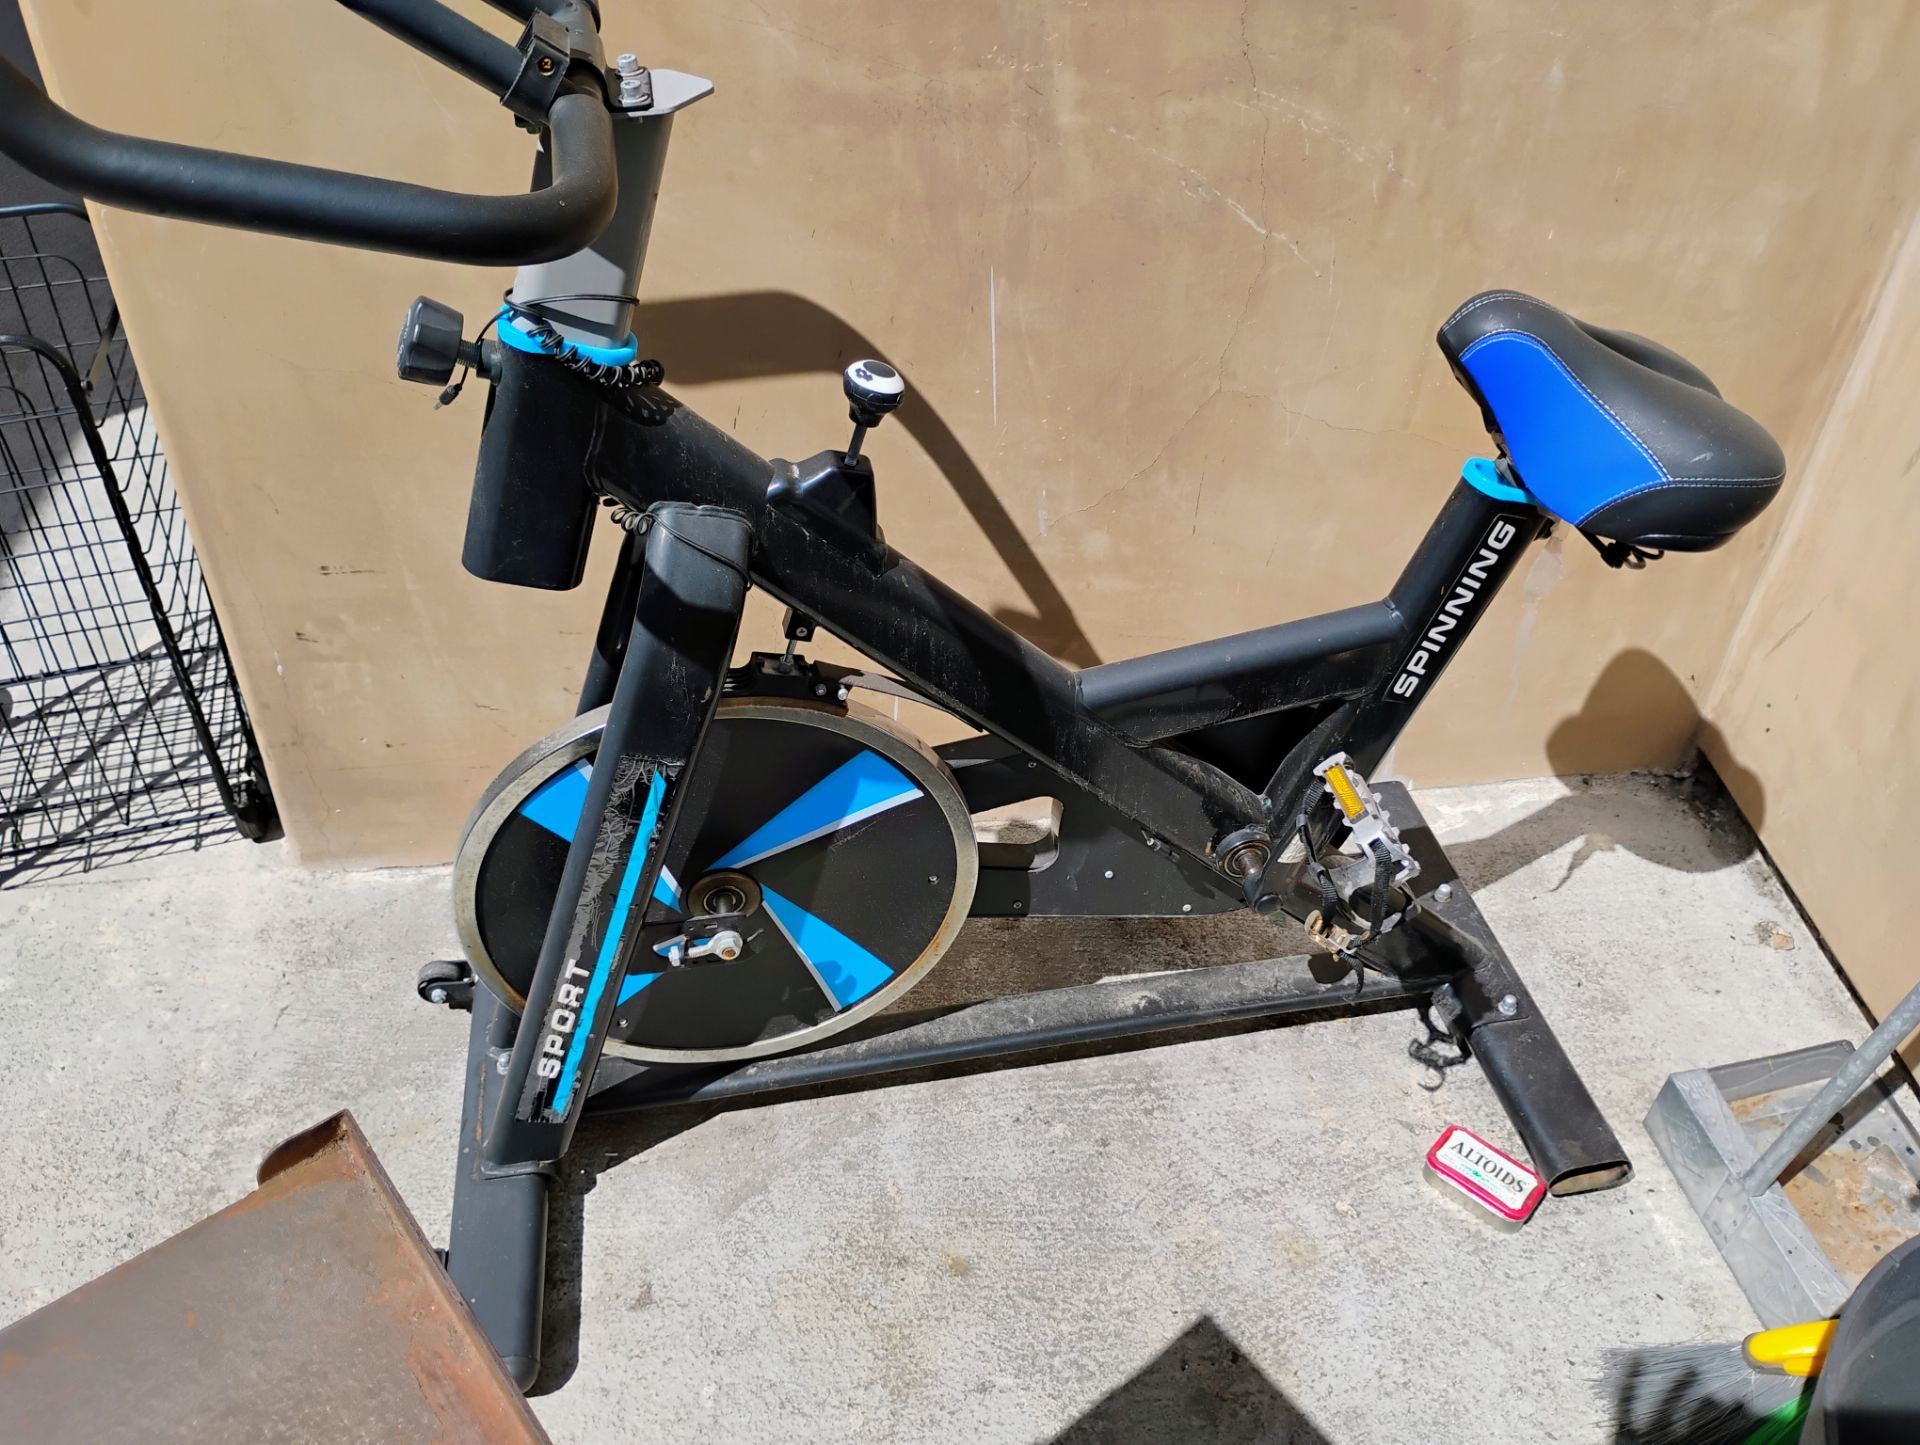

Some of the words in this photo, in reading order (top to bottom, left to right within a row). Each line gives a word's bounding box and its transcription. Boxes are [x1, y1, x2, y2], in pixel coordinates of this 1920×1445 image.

[1393, 520, 1516, 697] SPINNING
[537, 958, 590, 1079] SPORT
[1450, 1142, 1524, 1193] ALTOIDS
